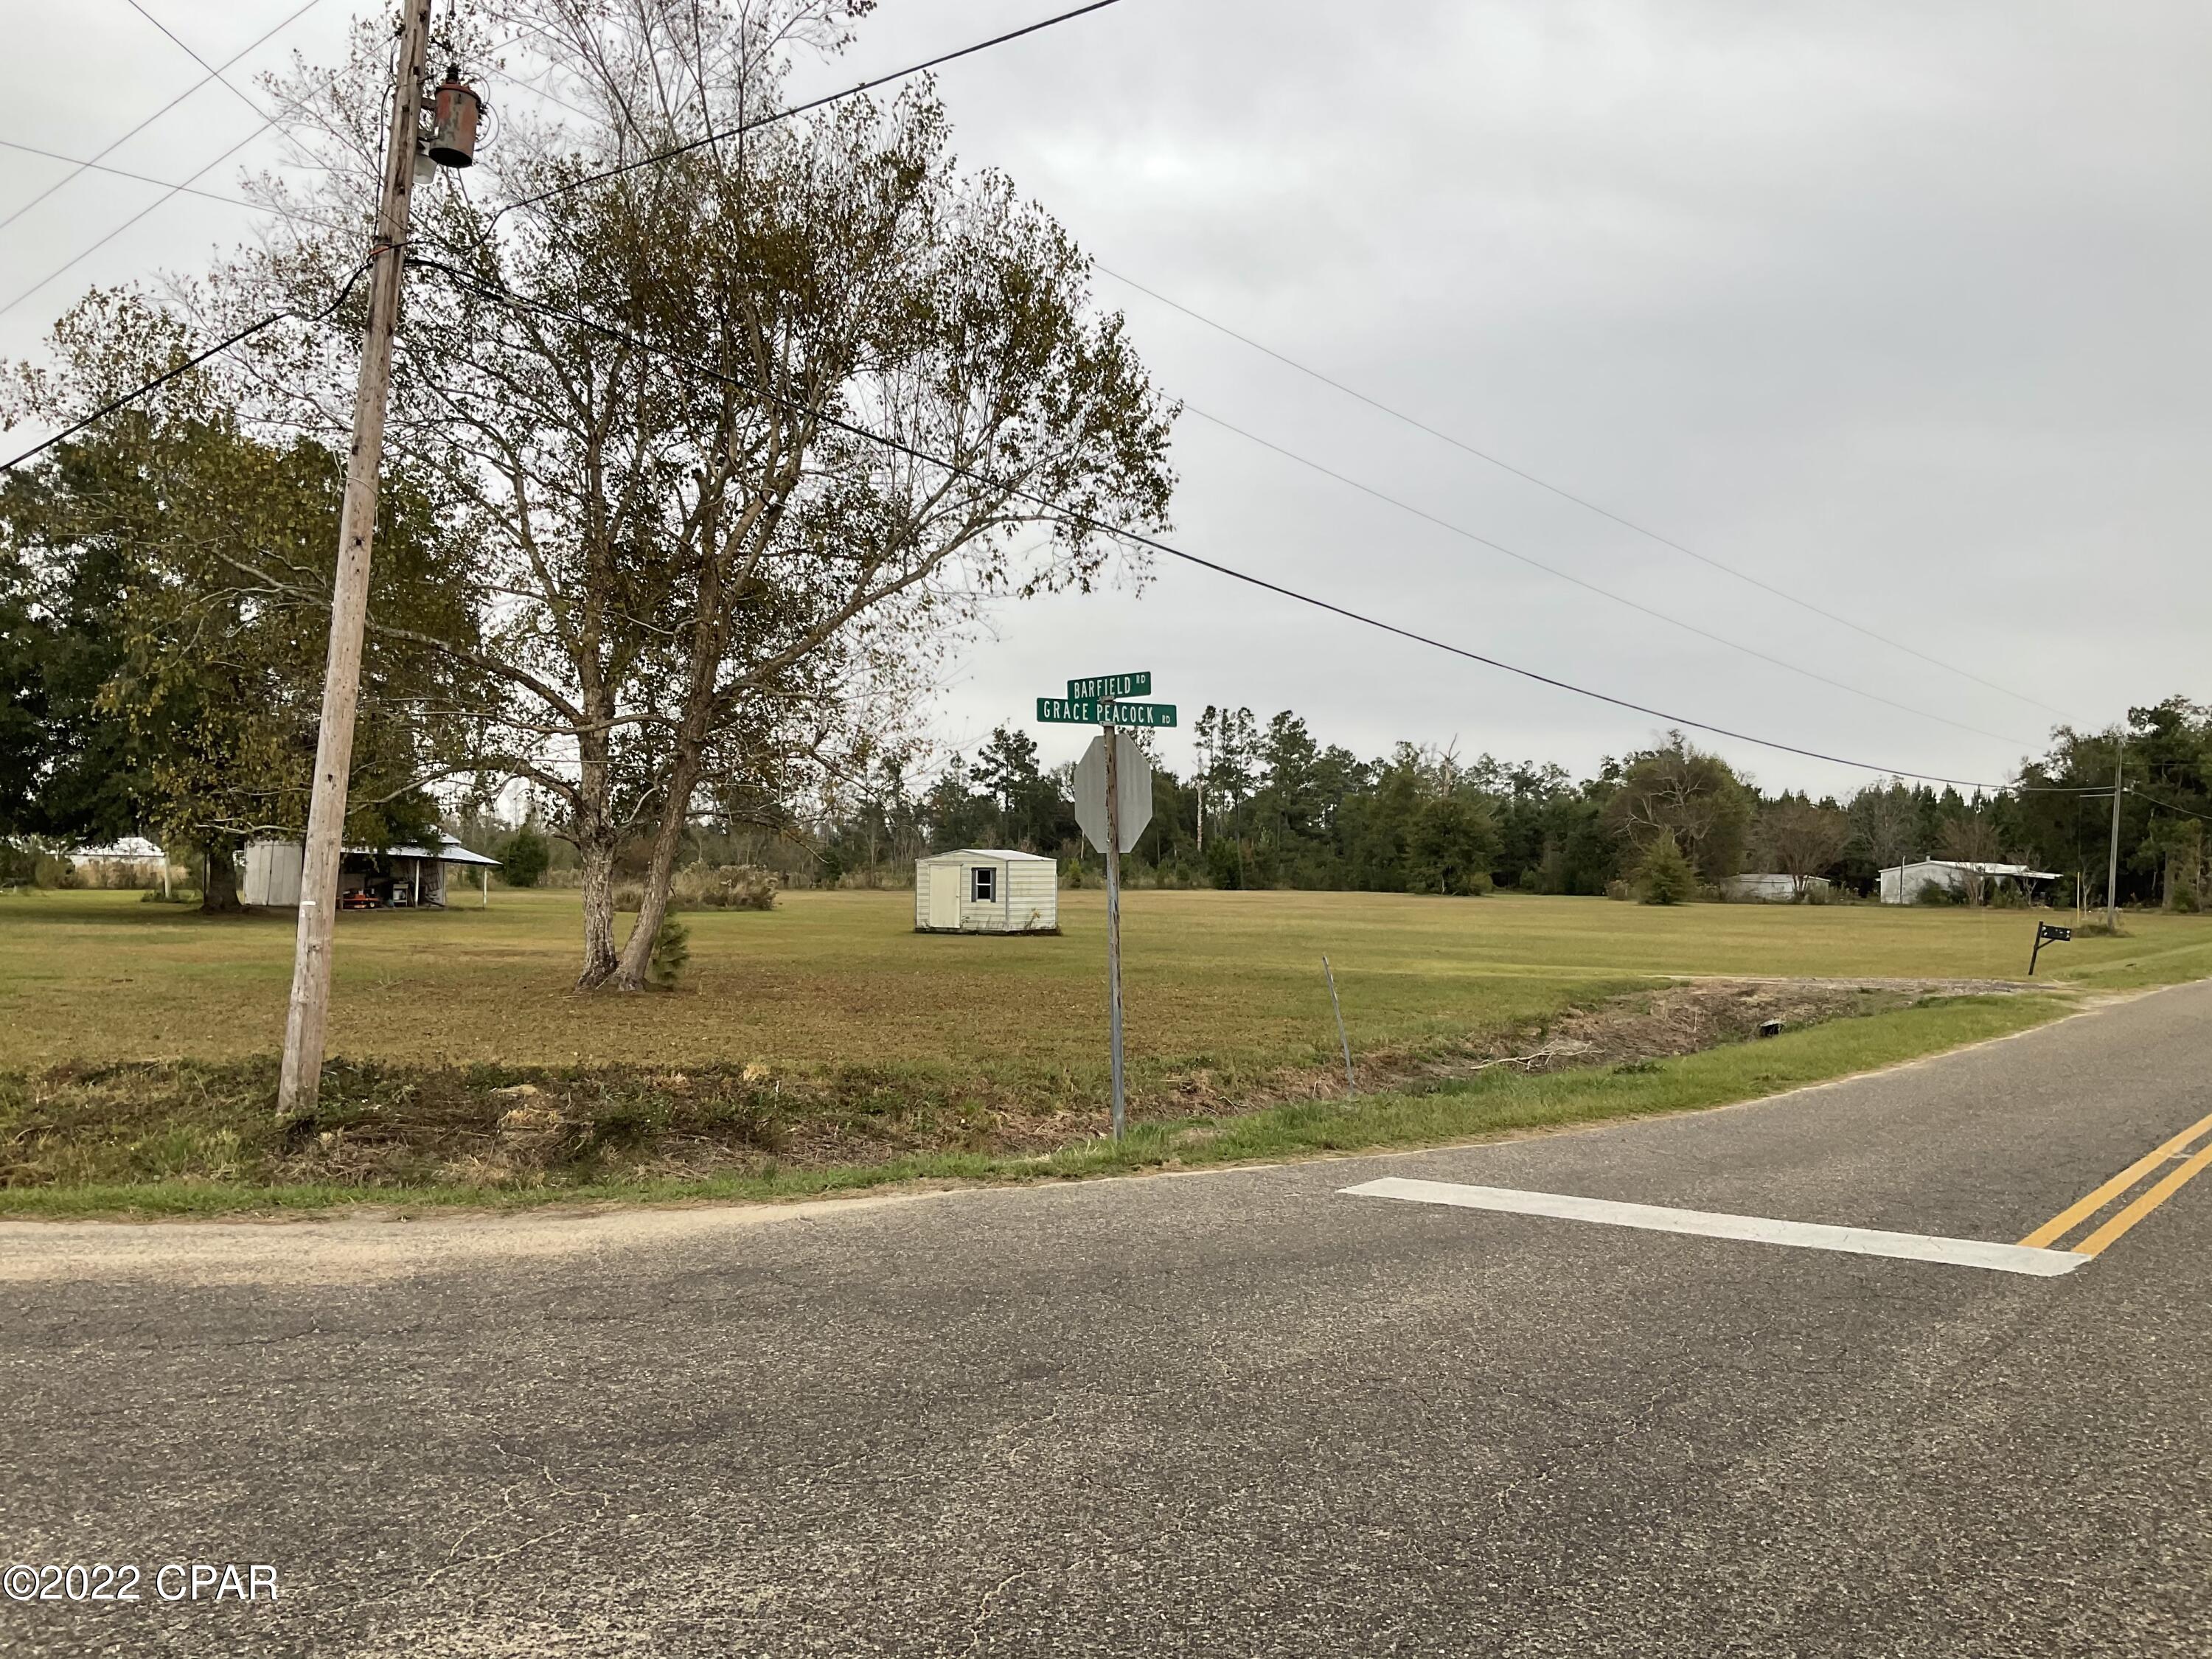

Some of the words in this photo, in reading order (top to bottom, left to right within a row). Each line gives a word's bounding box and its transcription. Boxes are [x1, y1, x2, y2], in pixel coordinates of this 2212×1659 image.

[1074, 676, 1131, 699] BARFIELD
[1135, 674, 1146, 684] RD
[1043, 700, 1088, 720] GRACE
[1096, 703, 1154, 723] PEACOCK
[1161, 714, 1171, 724] RD
